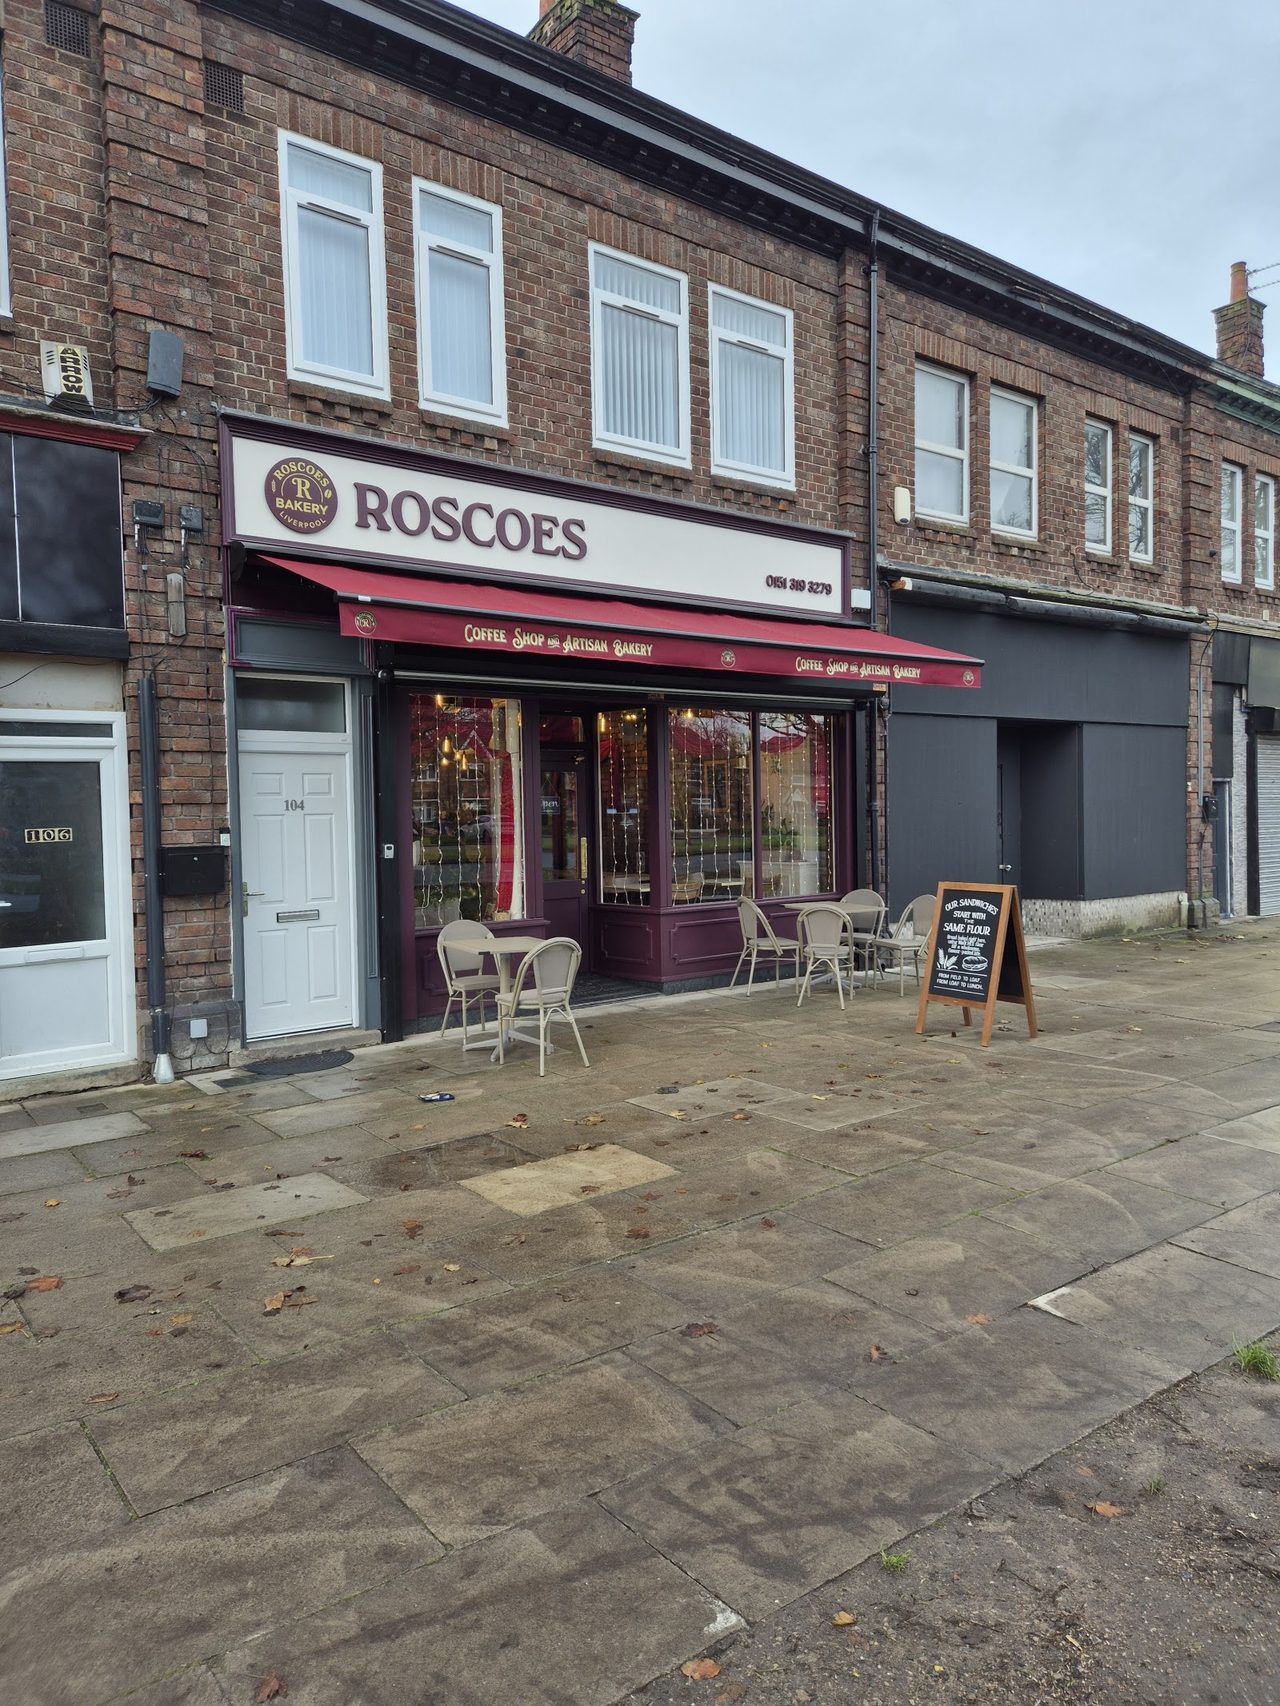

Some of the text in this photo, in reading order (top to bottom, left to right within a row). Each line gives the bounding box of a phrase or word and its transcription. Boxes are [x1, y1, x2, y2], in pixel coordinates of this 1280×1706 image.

[59, 347, 83, 393] ARROW
[273, 461, 330, 487] ROSCOES
[291, 477, 312, 500] R
[275, 497, 328, 515] BAKERY
[279, 510, 326, 529] LIVERPOOL
[353, 482, 588, 561] ROSCOES
[765, 574, 833, 596] 0151 319 3279
[284, 799, 304, 811] 104
[541, 799, 559, 811] pen
[30, 829, 70, 841] 106
[945, 898, 999, 915] OUR SANDWICHES
[953, 910, 987, 920] START WITH
[943, 922, 991, 936] SAME FLOUR
